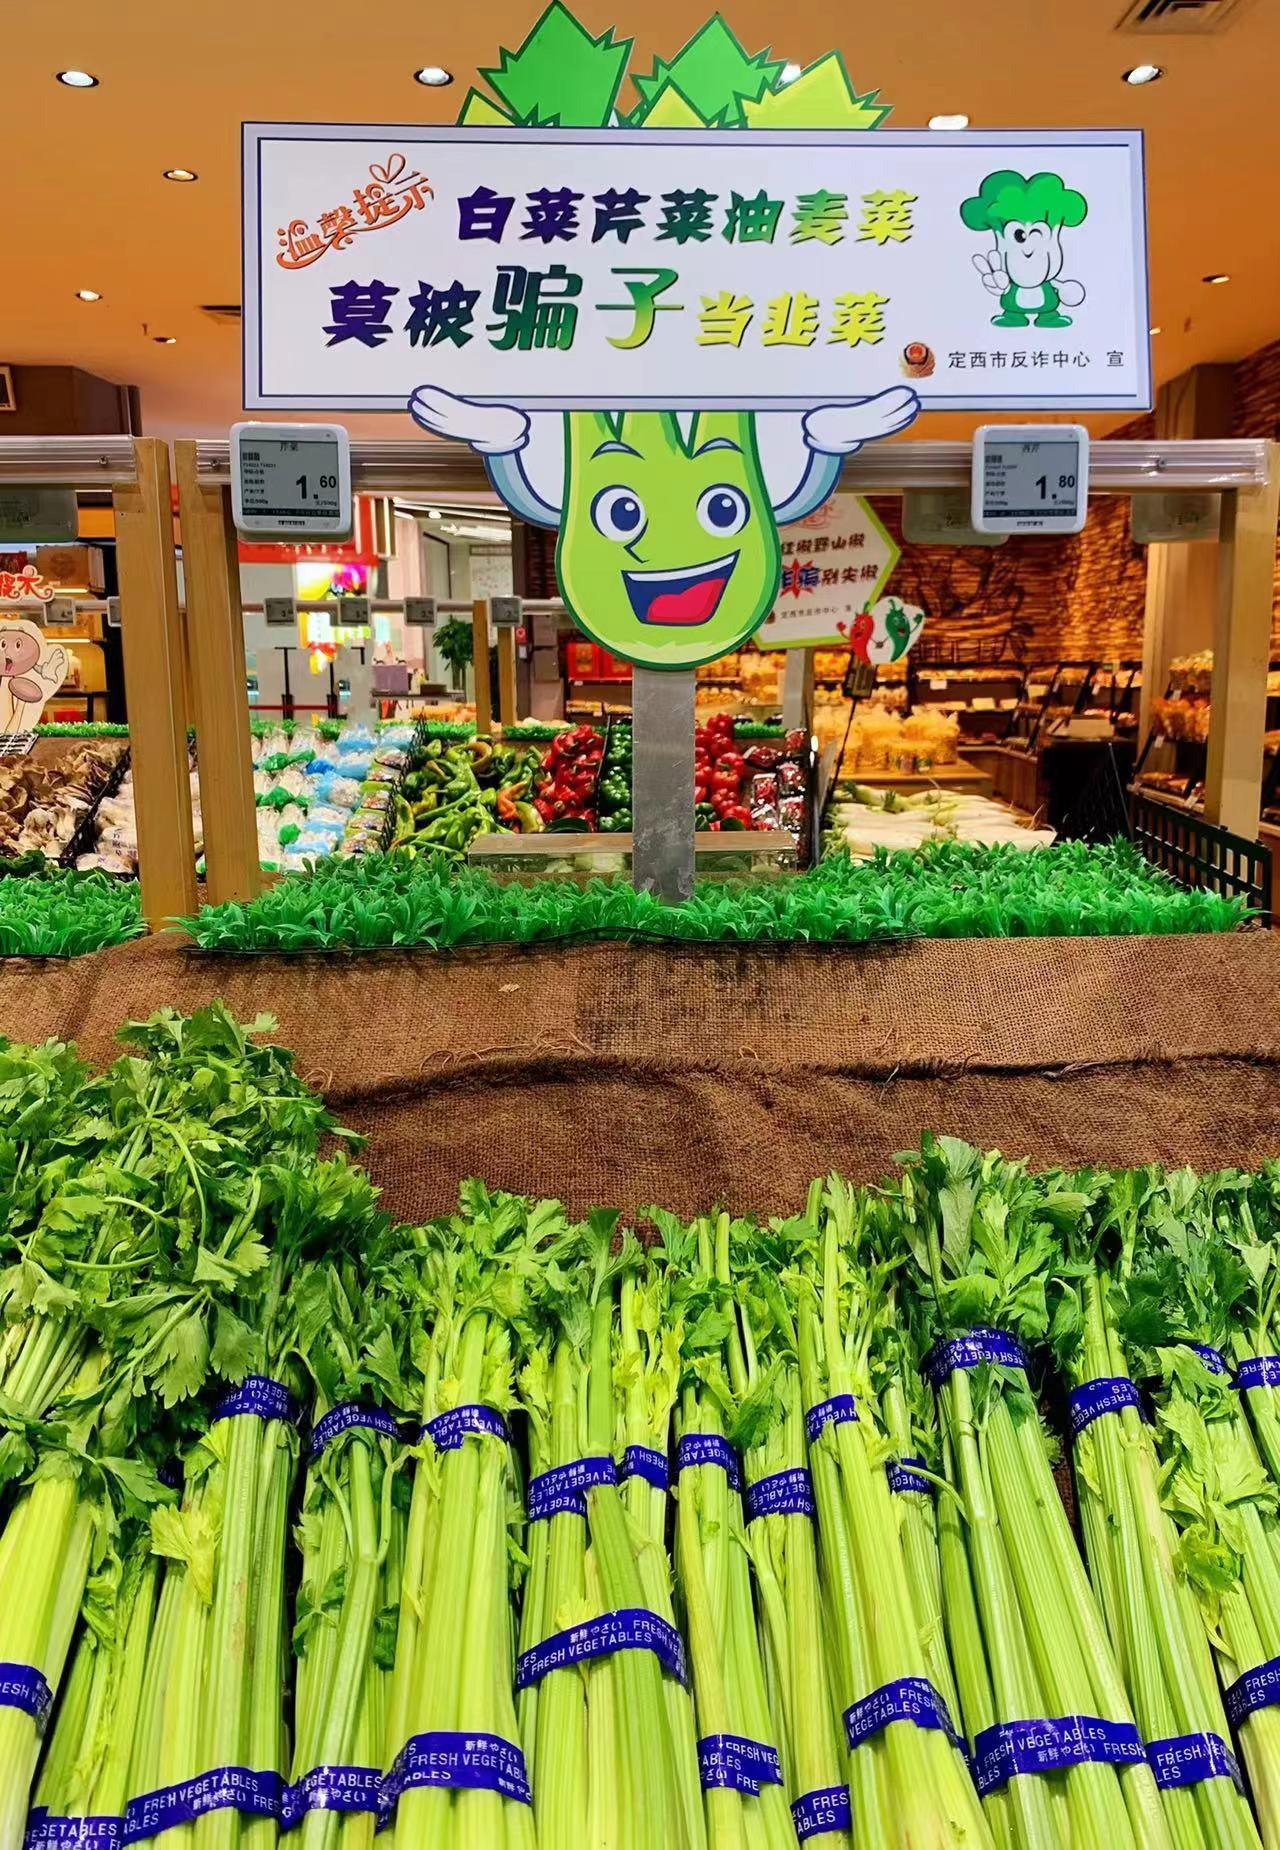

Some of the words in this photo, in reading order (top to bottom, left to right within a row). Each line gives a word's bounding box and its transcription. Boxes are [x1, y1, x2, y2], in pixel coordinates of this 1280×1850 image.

[276, 160, 434, 270] 温馨提示
[456, 185, 918, 246] 白菜芹菜油麦菜
[322, 264, 890, 351] 莫被骗子当韭菜
[948, 351, 1091, 370] 定西市反诈中心
[1106, 350, 1125, 369] 宣
[531, 1648, 565, 1675] FRESH
[568, 1631, 652, 1657] VEGETABLES
[849, 1701, 921, 1739] VEGETABLES
[410, 1752, 458, 1768] FRESH
[984, 1740, 1015, 1768] FRESH
[1017, 1728, 1106, 1751] VEGETABLES
[1156, 1744, 1202, 1767] FRESH
[179, 1774, 259, 1803] VEGETABLES
